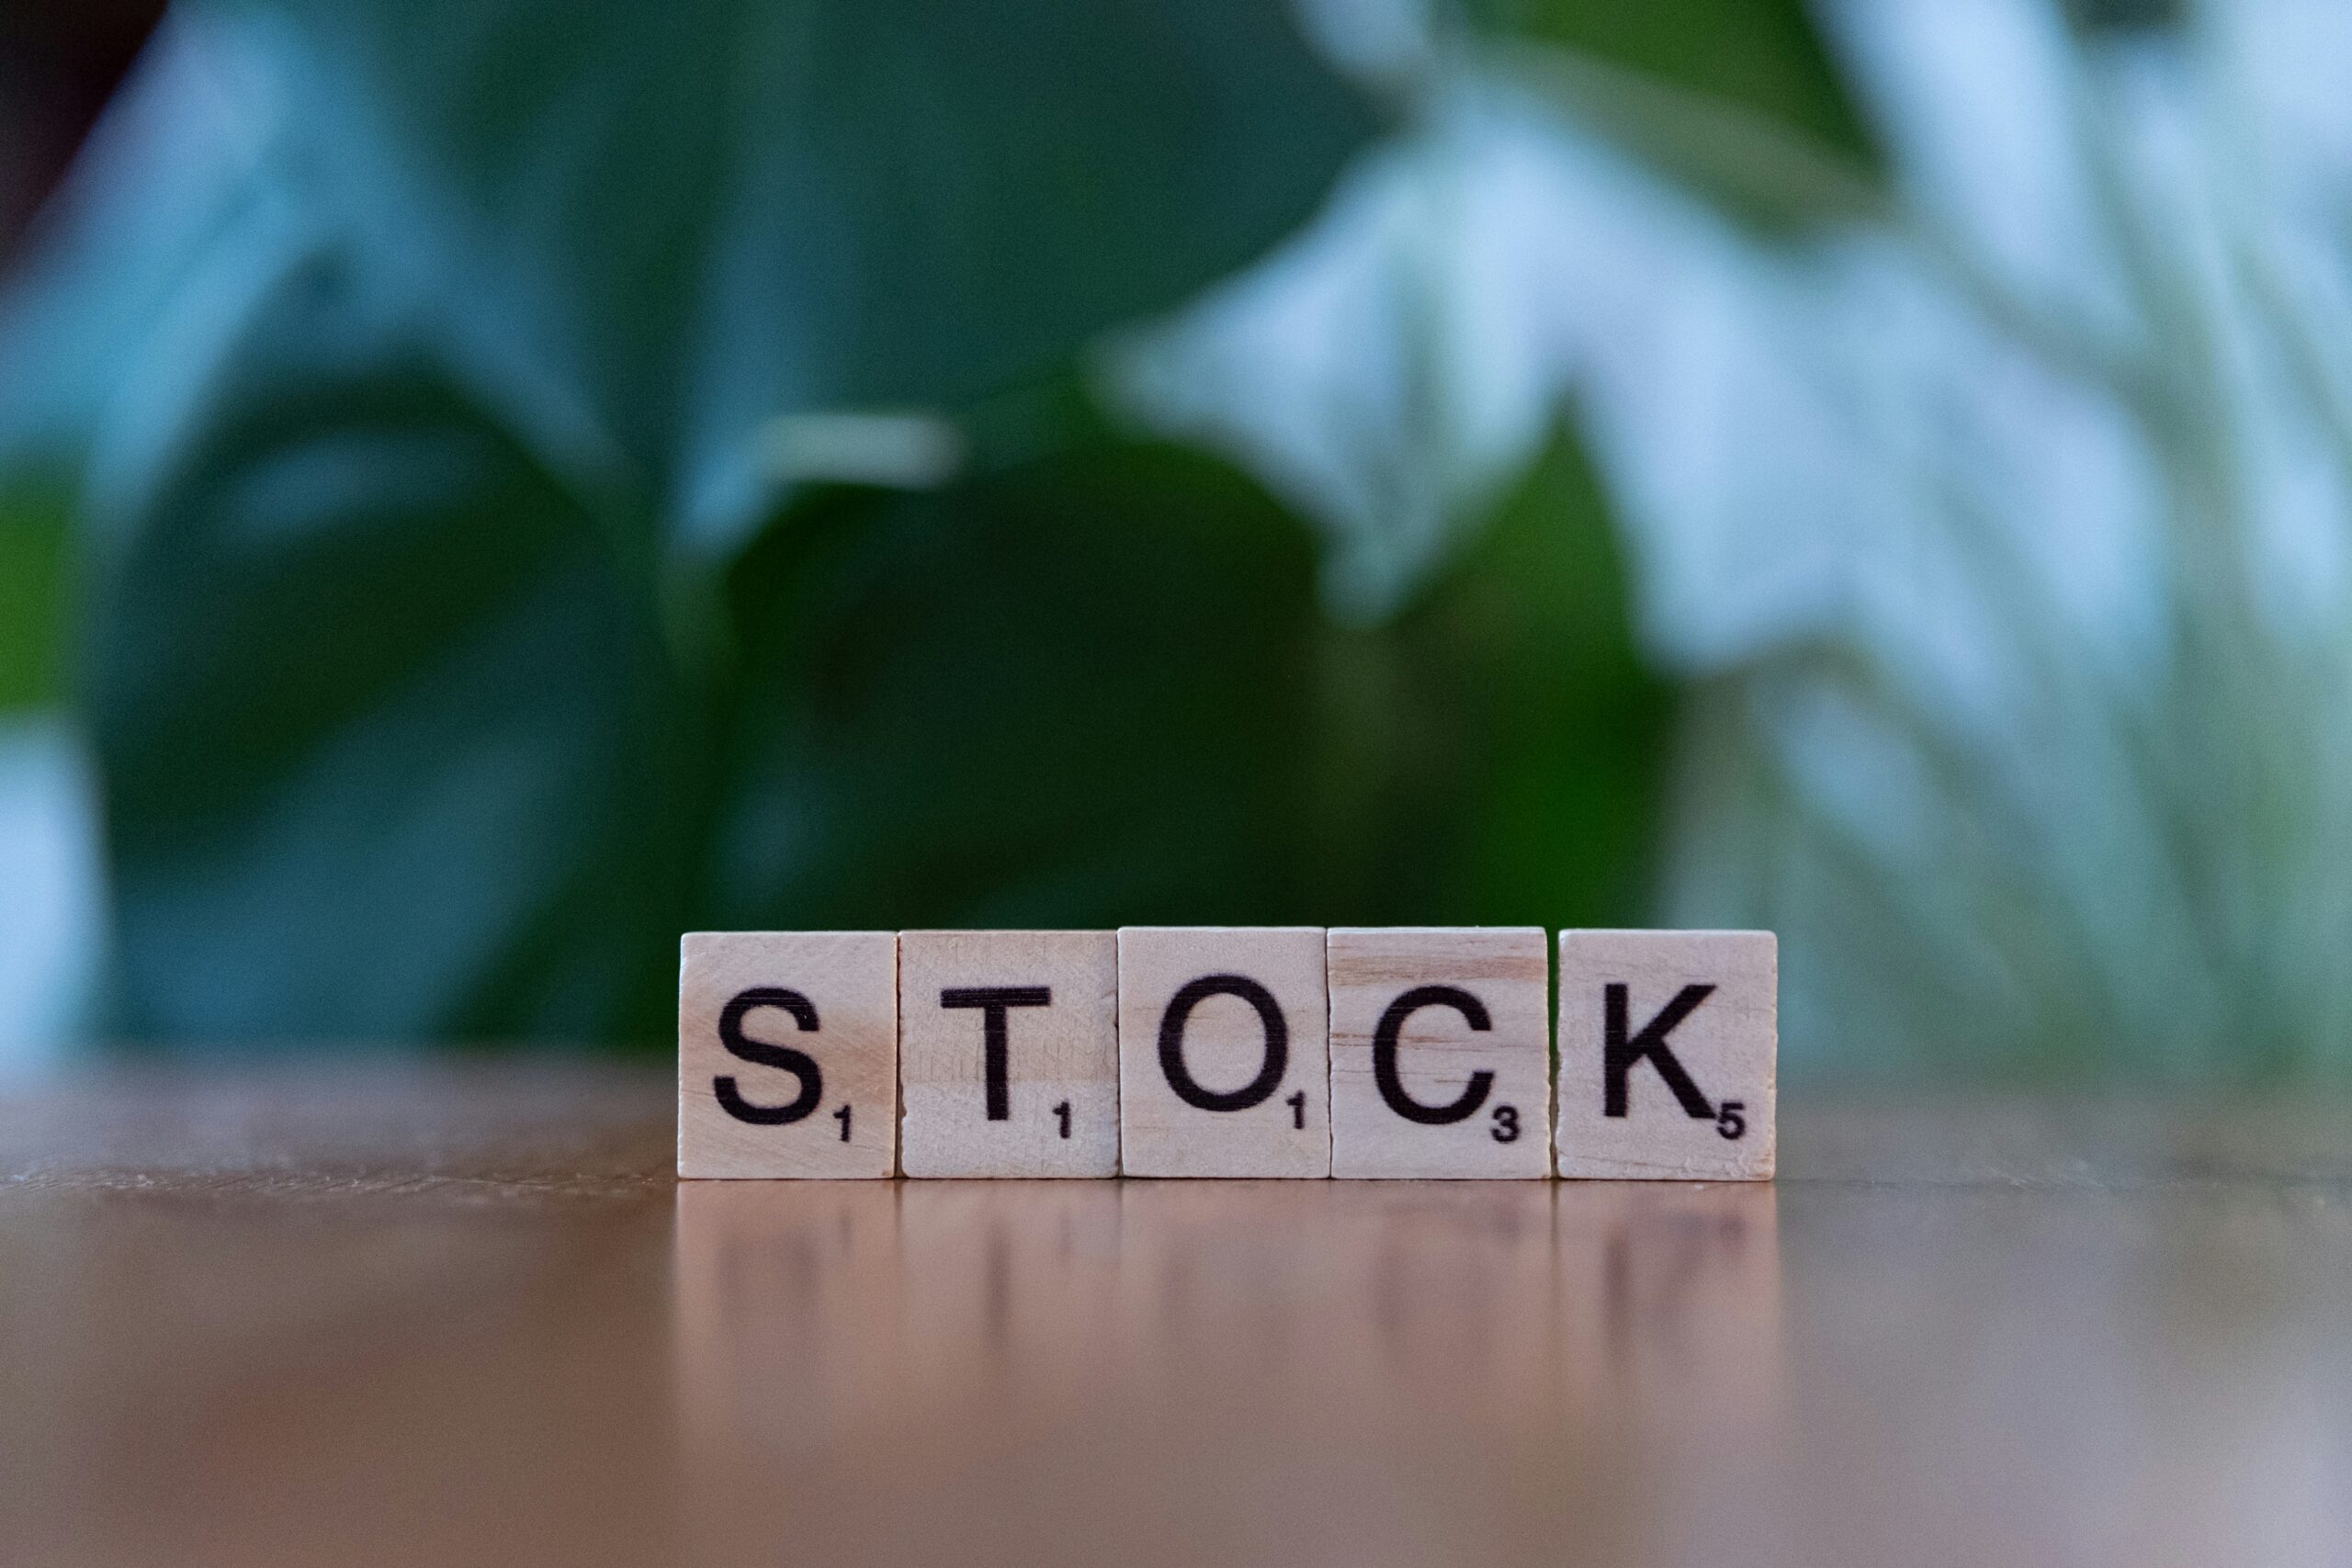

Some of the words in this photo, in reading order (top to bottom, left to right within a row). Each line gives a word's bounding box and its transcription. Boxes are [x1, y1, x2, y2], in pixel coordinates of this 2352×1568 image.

[712, 973, 1718, 1126] STOCK
[832, 1104, 852, 1143] 1
[1052, 1100, 1071, 1140] 1
[1286, 1090, 1306, 1130] 1
[1490, 1105, 1521, 1145] 3
[1716, 1102, 1746, 1141] 5
